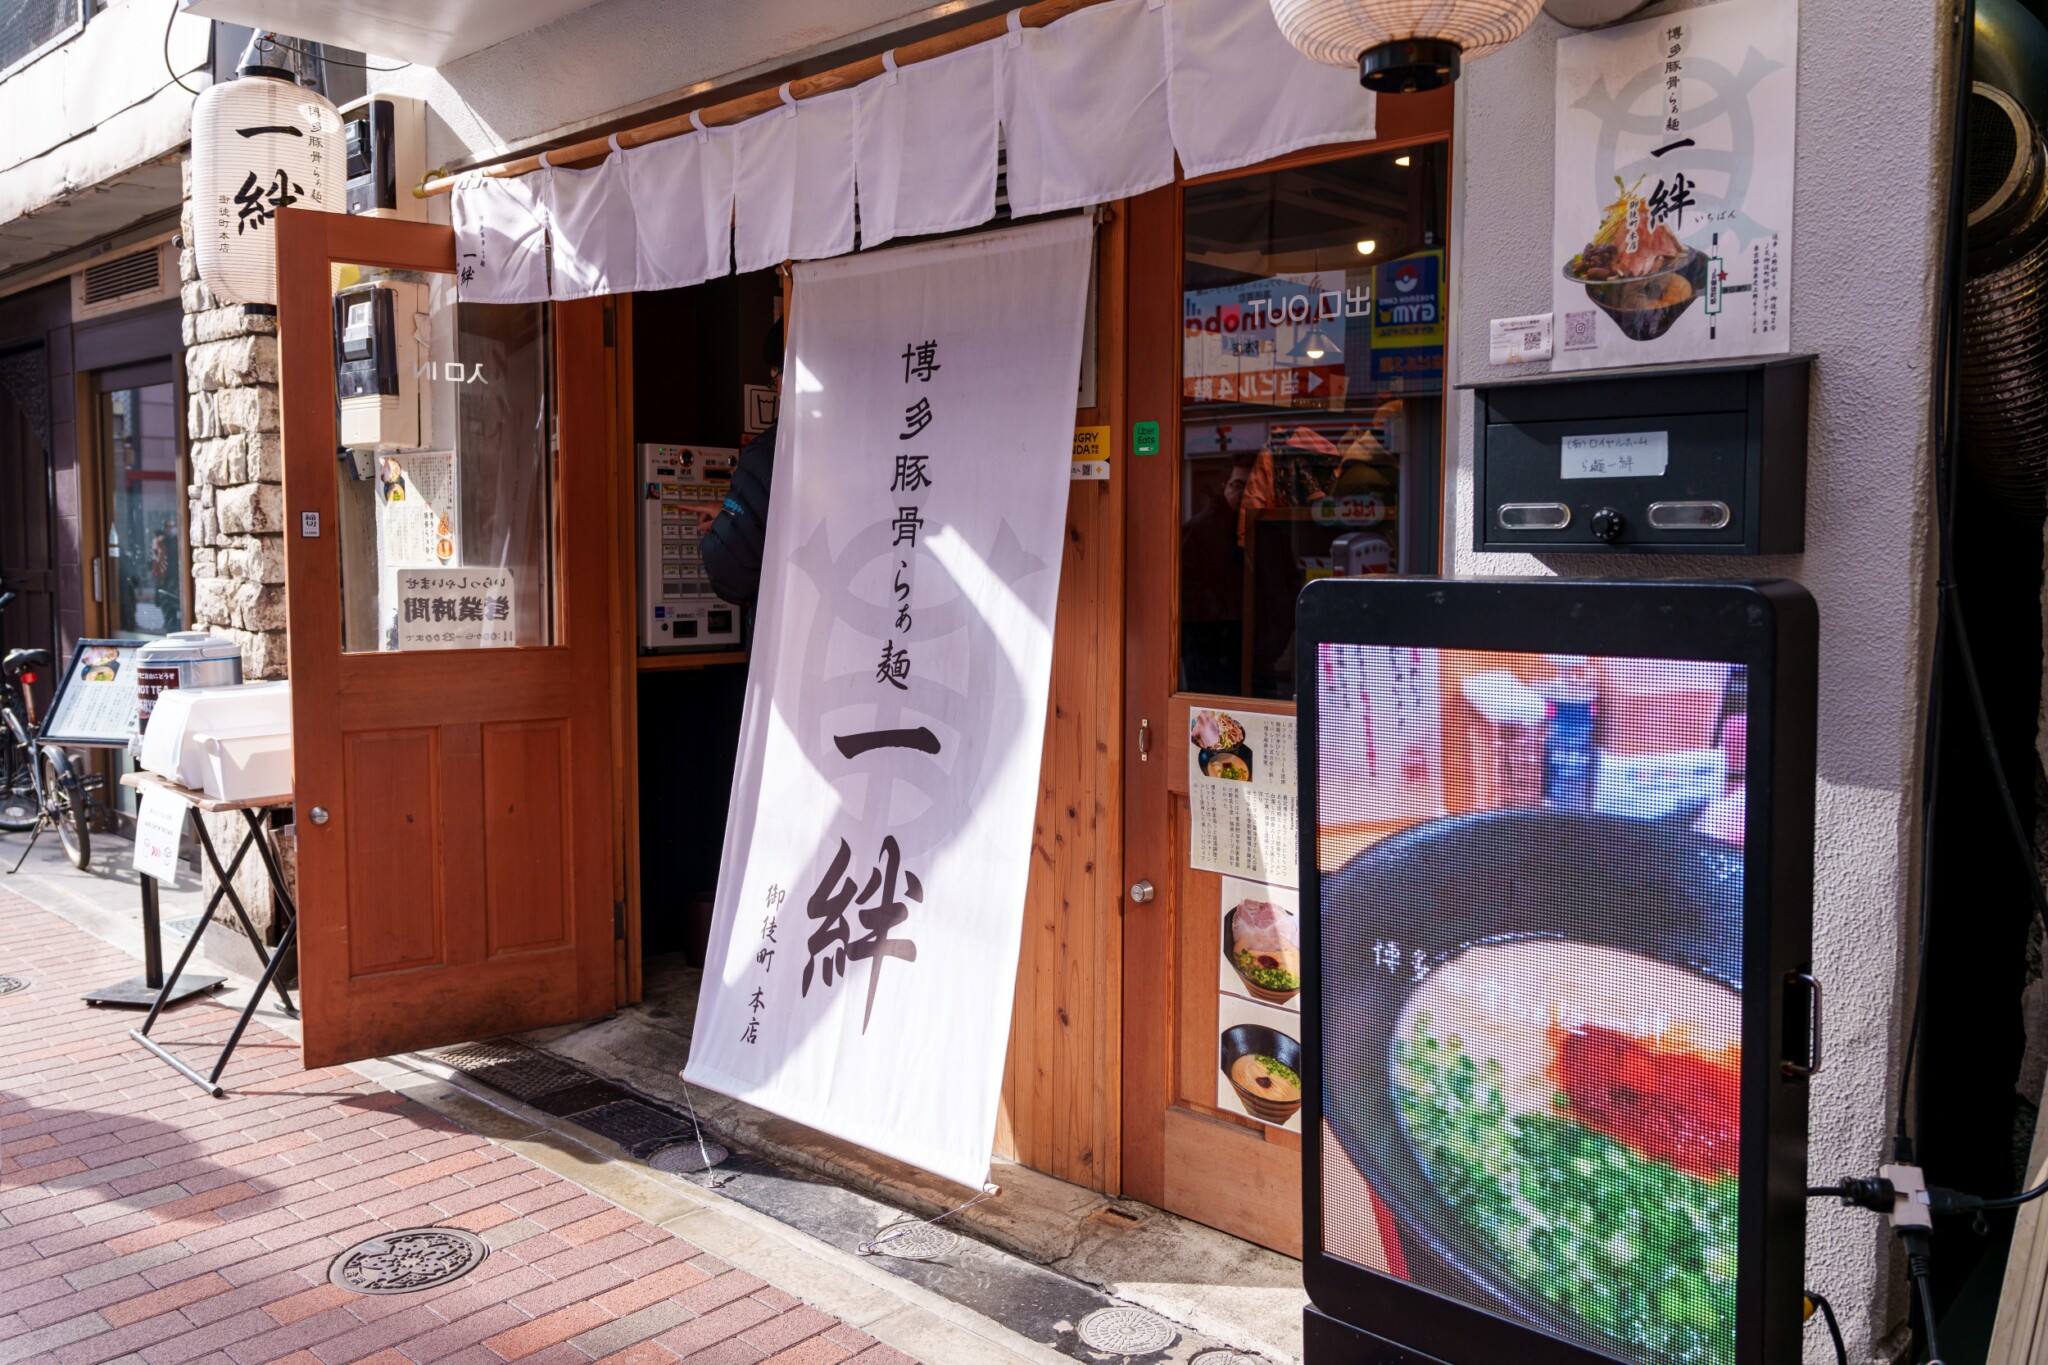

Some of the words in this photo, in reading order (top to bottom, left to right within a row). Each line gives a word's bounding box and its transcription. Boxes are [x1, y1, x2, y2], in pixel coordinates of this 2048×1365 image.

[1664, 26, 1683, 132] 博多豚骨らぁ麺
[234, 125, 304, 236] 一絆
[308, 105, 324, 204] 博多豚骨らぁ麺
[1648, 138, 1695, 231] 一絆
[218, 194, 231, 254] 御徒町本店
[1627, 200, 1639, 252] 御徒町本店
[1695, 209, 1736, 223] いちばん
[461, 253, 477, 288] 一絆
[1137, 427, 1155, 435] Uber
[1137, 436, 1155, 445] Eats
[876, 339, 941, 691] 博多豚骨らぁ麺
[801, 726, 942, 1036] 一絆
[740, 884, 786, 1045] 御徒町本店
